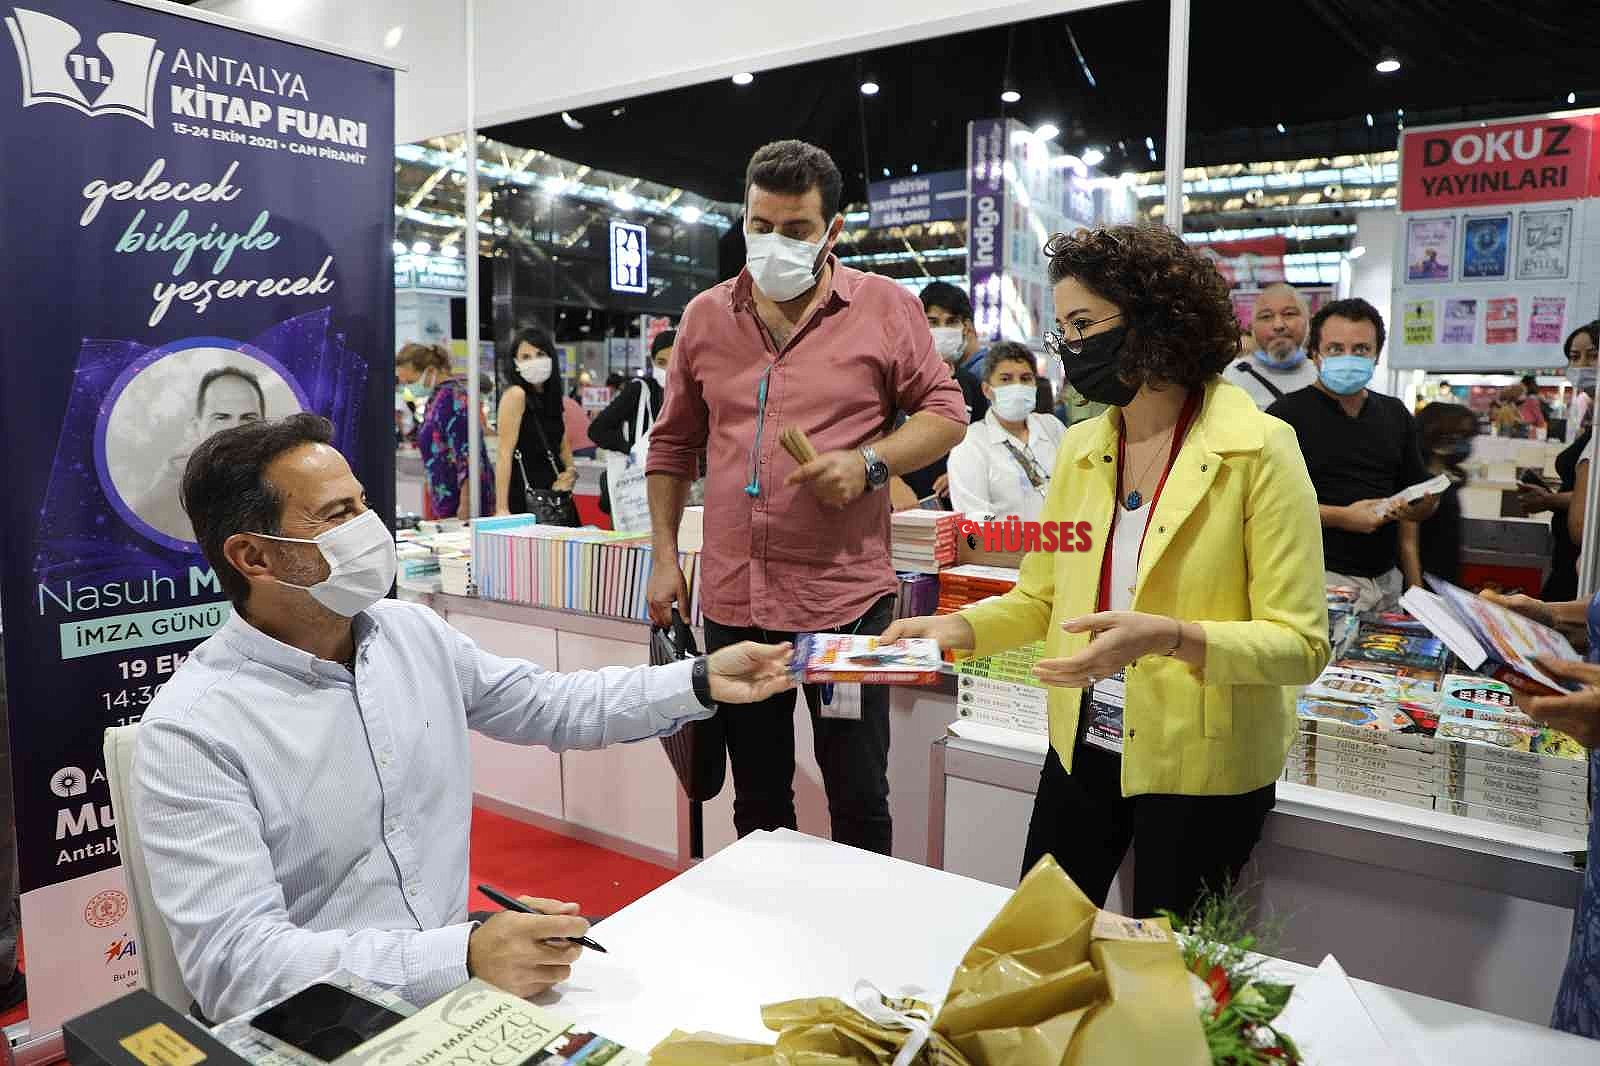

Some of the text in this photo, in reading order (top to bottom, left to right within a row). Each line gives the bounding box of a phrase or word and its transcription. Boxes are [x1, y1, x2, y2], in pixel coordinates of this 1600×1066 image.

[171, 48, 309, 101] ANTALYA
[171, 83, 368, 148] KİTAP FUARI
[172, 122, 210, 139] 15-24
[248, 135, 278, 150] 2021
[289, 142, 317, 156] CAM
[1423, 125, 1571, 168] DOKUZ
[79, 158, 243, 227] gelecek
[1422, 165, 1568, 197] YAYINLARI
[114, 209, 281, 276] bilgiyle
[148, 256, 335, 328] yeşerecek
[38, 565, 224, 616] Nasuh M
[76, 607, 221, 647] İMZA GÜNÜ
[118, 650, 192, 680] 19 EK
[55, 802, 116, 841] Mu
[55, 836, 120, 866] Antaly
